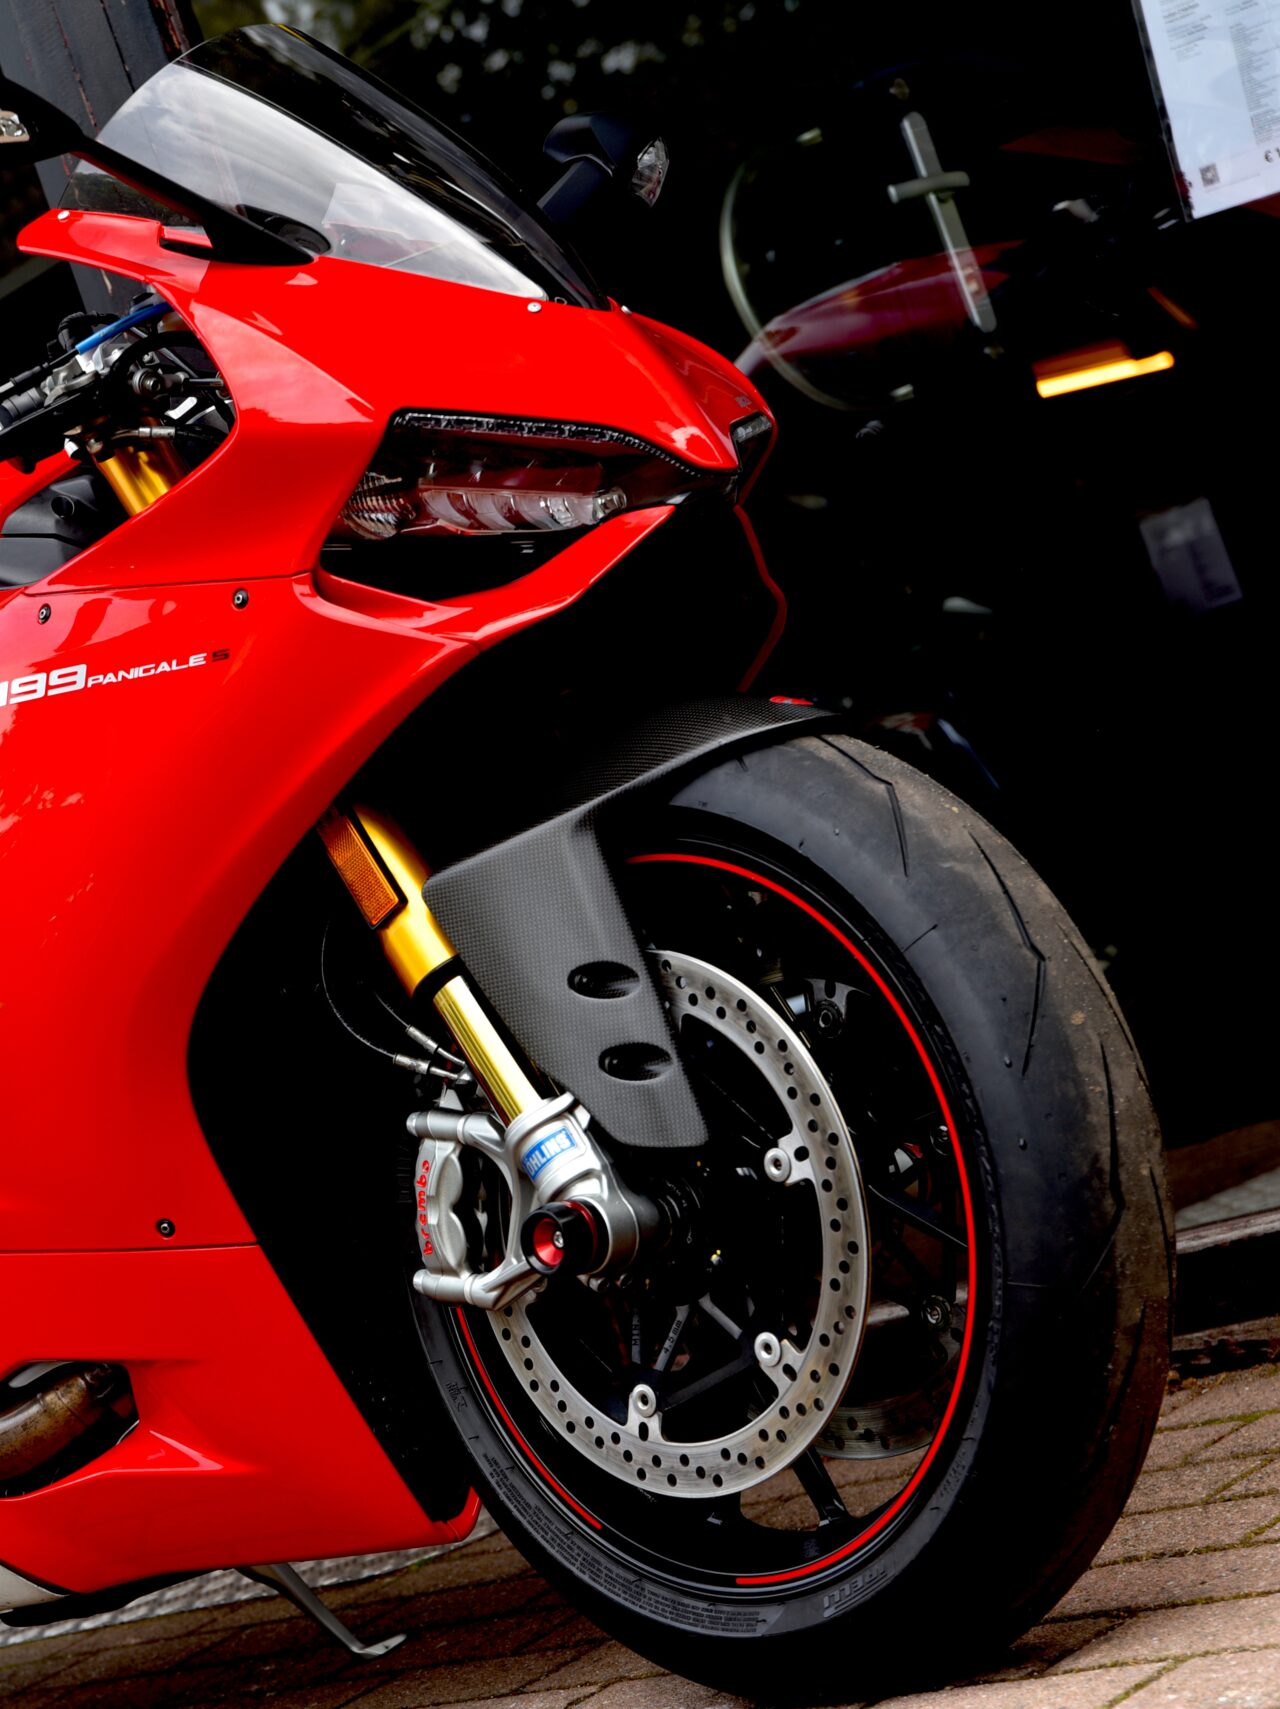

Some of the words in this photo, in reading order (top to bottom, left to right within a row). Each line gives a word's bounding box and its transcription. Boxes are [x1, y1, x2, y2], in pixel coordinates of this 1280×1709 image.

[87, 653, 207, 688] PANIGALE
[211, 648, 230, 663] S
[416, 1160, 433, 1256] brembo
